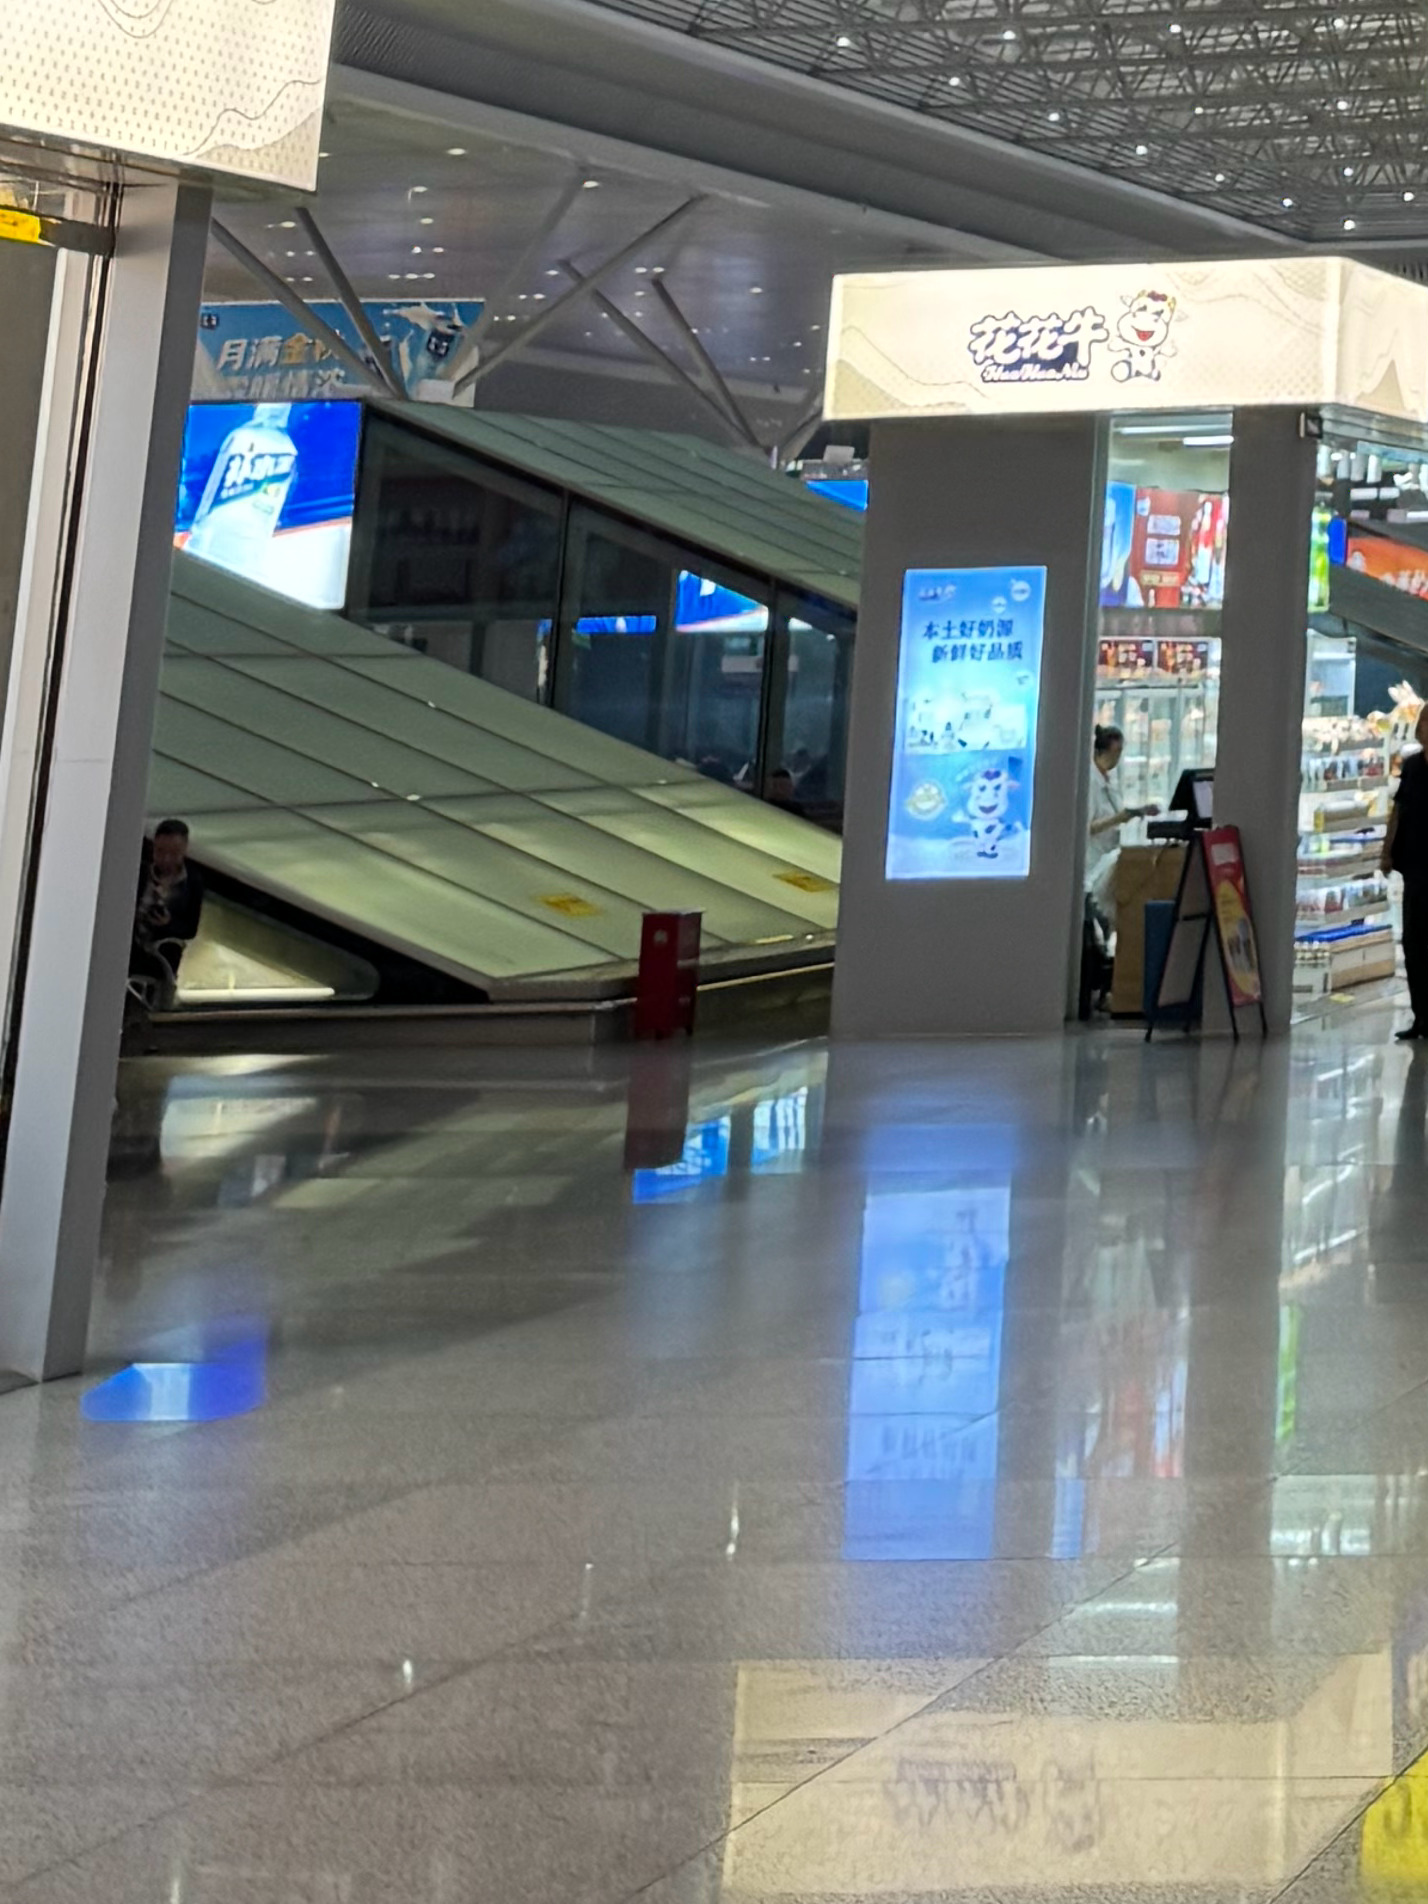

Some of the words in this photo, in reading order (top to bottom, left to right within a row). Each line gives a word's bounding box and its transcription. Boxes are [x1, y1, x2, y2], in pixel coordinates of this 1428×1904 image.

[967, 306, 1110, 366] 花花牛
[921, 618, 1014, 641] 本土好奶源
[931, 640, 1023, 664] 新鲜好品质
